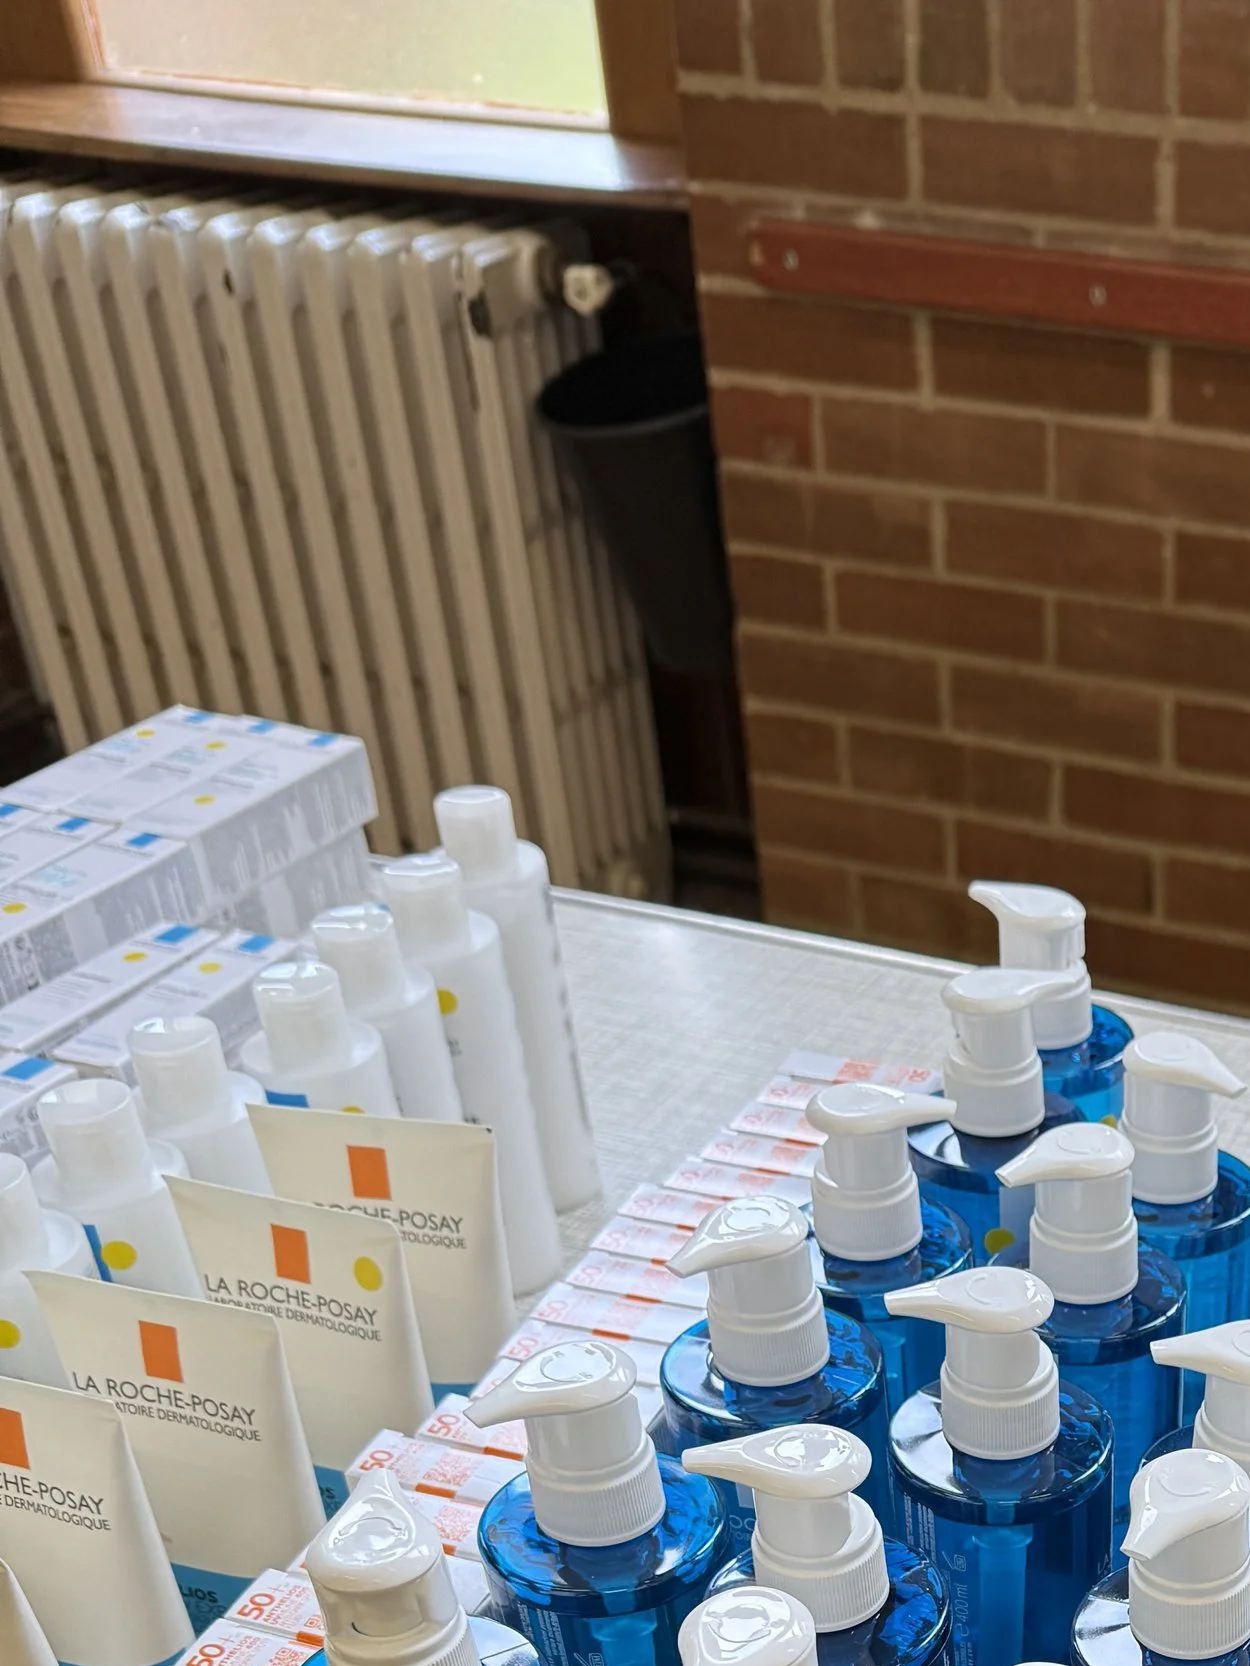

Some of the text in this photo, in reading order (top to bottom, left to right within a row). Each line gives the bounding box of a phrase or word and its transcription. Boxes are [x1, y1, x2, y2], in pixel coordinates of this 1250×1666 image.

[204, 1273, 232, 1296] LA
[238, 1279, 378, 1326] ROCHE-POSAY
[286, 1308, 383, 1342] DERMATOLOGIQUE
[508, 1336, 539, 1358] 50
[72, 1371, 256, 1426] LA ROCHE-POSAY
[115, 1402, 262, 1442] ATOIRE DERMATOLOGIQUE
[427, 1413, 461, 1437] 50
[0, 1472, 104, 1515] HE-POSAY
[4, 1494, 112, 1531] DERMATOLOGIQUE
